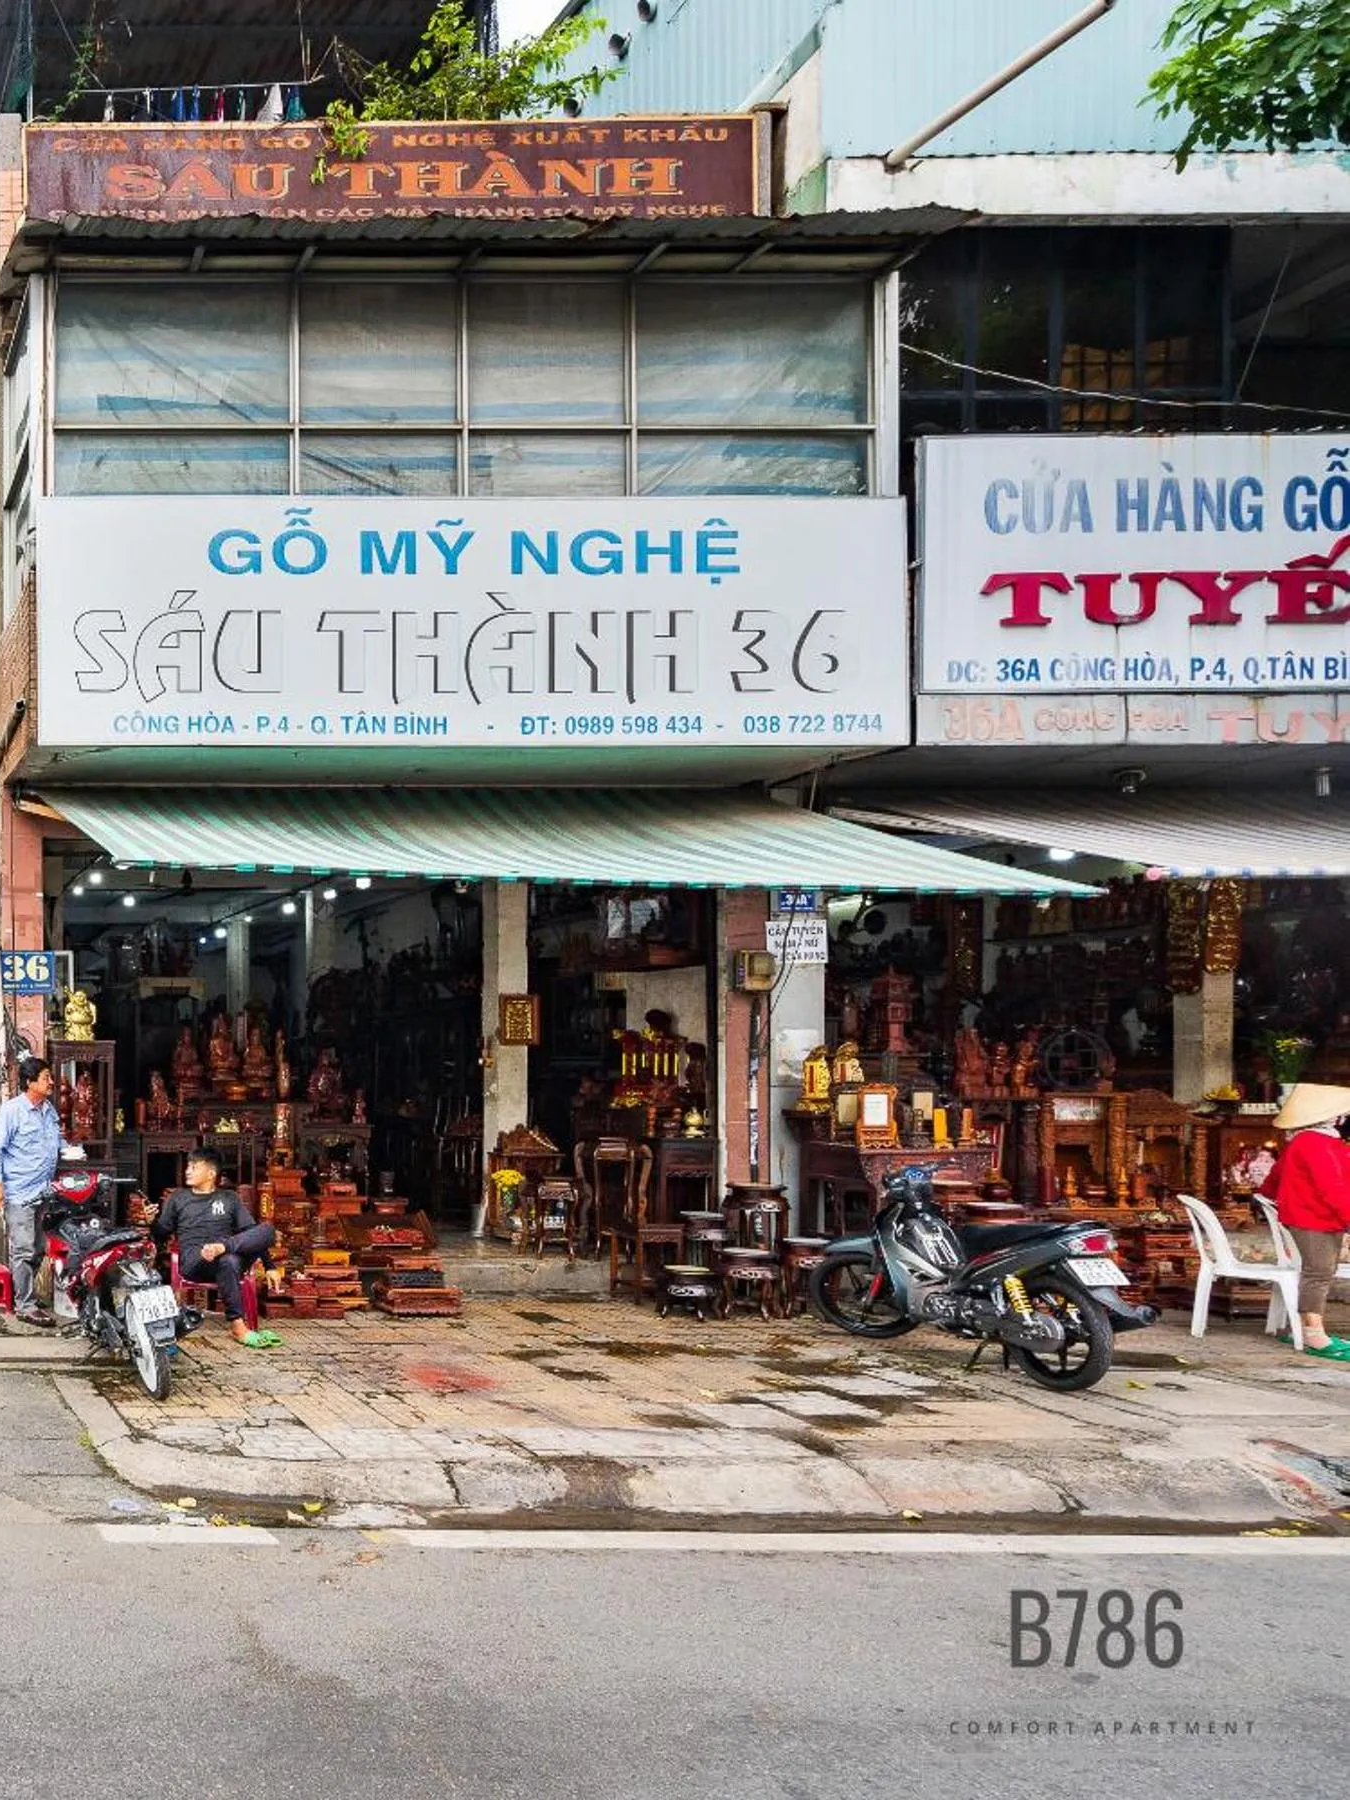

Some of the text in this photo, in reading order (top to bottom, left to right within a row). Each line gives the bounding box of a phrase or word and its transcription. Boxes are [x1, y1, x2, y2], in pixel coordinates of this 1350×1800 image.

[327, 150, 684, 200] THÀNH
[1115, 461, 1264, 534] HÀNG
[207, 506, 741, 585] GỖ MỸ NGHỆ
[73, 589, 850, 705] SÁU THÀNH 36
[996, 657, 1041, 682] 36A
[1123, 651, 1180, 685] HÒA,
[1189, 656, 1235, 686] P.4,
[187, 709, 236, 734] HÒA
[256, 714, 290, 734] P.4
[339, 710, 387, 735] TÂN
[519, 715, 557, 736] ĐT:
[564, 715, 615, 736] 0989
[620, 715, 659, 735] 598
[665, 715, 704, 735] 434
[742, 714, 782, 734] 038
[788, 714, 826, 734] 722
[831, 713, 884, 734] 8744
[944, 698, 1025, 741] 36A
[3, 955, 49, 982] 36
